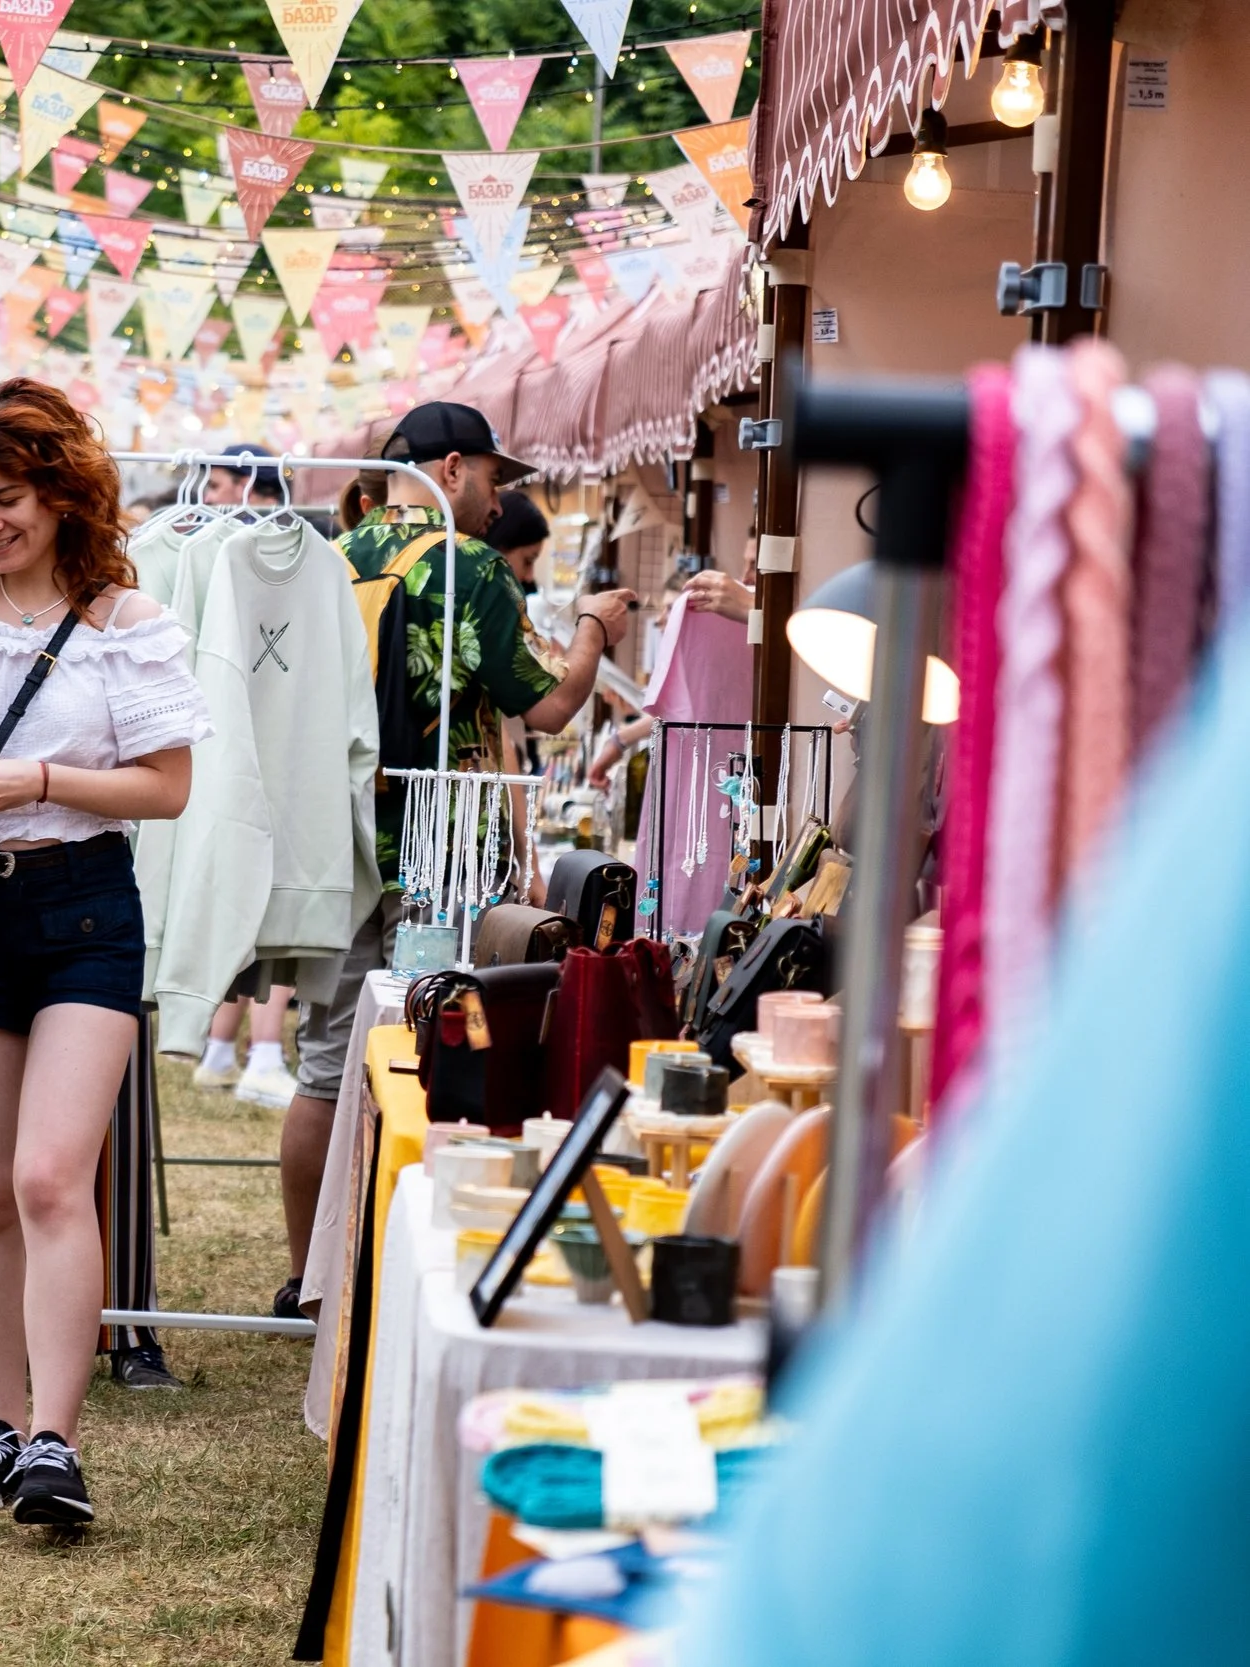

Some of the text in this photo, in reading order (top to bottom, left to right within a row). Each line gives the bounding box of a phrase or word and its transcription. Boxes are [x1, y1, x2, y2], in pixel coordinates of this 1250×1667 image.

[282, 6, 338, 24] БАЗАР
[707, 147, 748, 174] БАЗА
[241, 160, 289, 183] БАЗАР
[468, 184, 514, 199] БАЗАР
